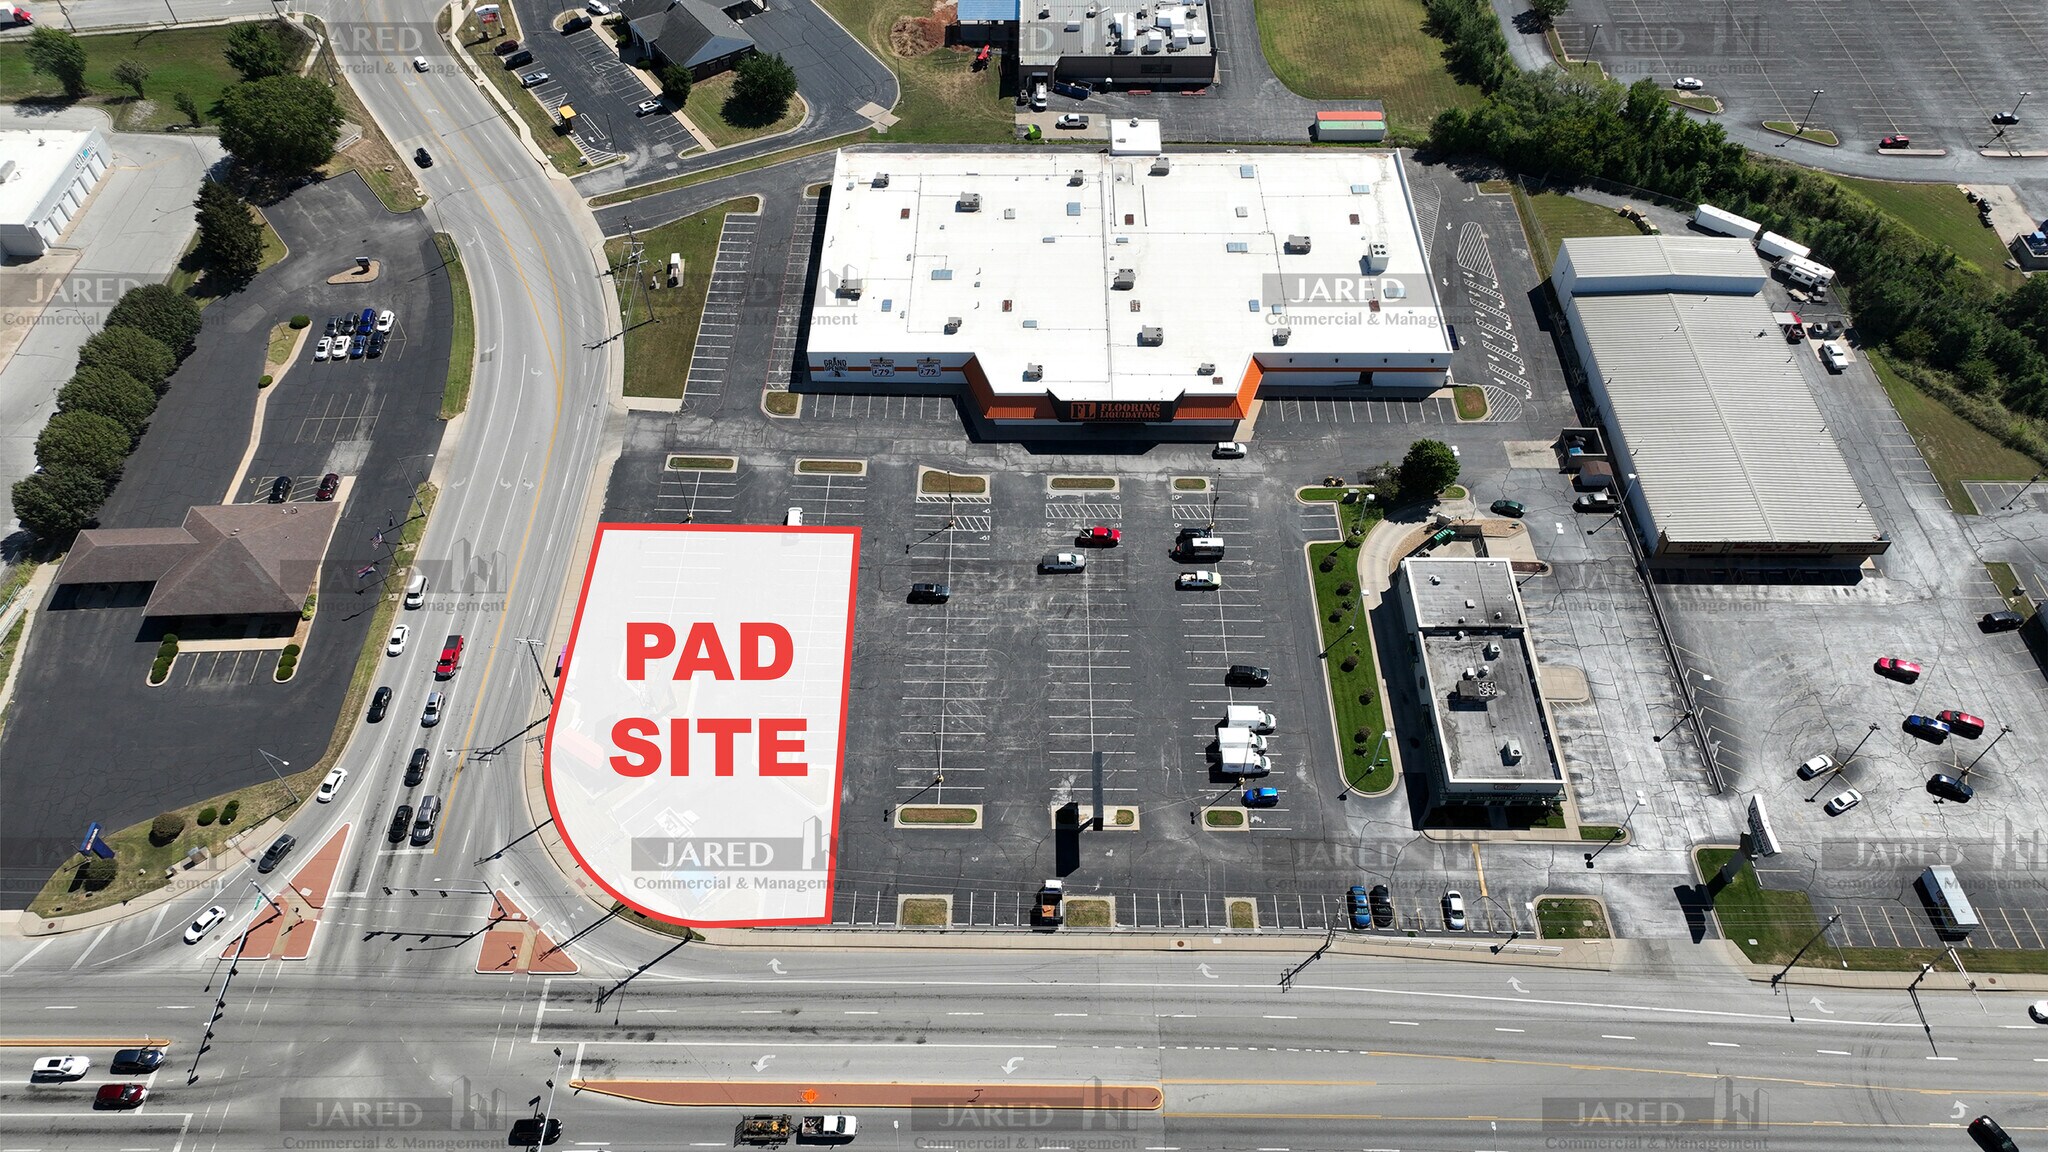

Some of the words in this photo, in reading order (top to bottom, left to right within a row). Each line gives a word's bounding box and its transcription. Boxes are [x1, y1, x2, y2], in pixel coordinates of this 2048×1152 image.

[823, 357, 847, 366] GRAND
[1072, 403, 1095, 418] FL
[1100, 403, 1160, 411] FLOORING
